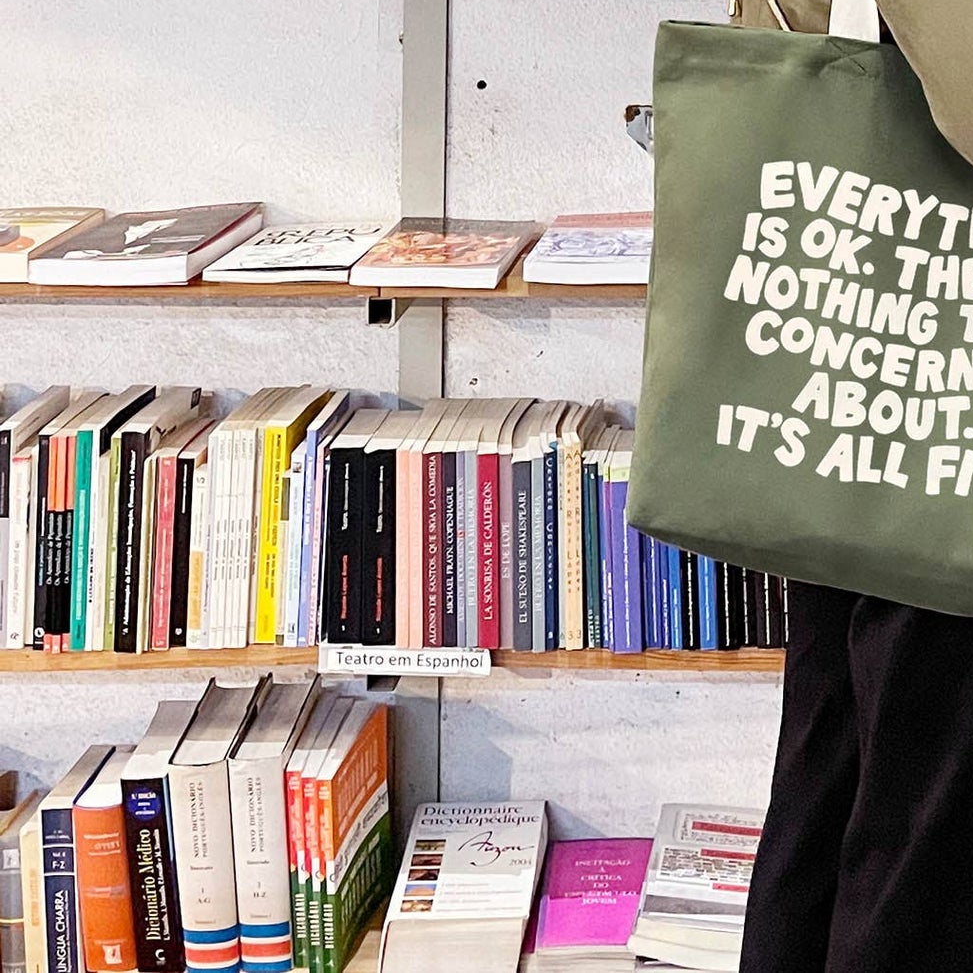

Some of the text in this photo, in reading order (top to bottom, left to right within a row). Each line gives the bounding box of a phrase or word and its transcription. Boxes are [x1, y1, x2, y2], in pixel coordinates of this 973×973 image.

[742, 212, 789, 258] IS
[800, 218, 875, 275] OK.
[723, 254, 939, 345] NOTHING
[717, 404, 811, 466] IT'S
[815, 433, 909, 489] ALL
[445, 486, 455, 544] COPENHAGUE
[427, 455, 438, 645] ALONSO DE SANTOS. QUE SIGA LA COMEDIA
[465, 488, 475, 607] BUERO EN LA MEMORIA
[481, 481, 494, 620] LA SONRISA DE CALDERÓN
[500, 522, 511, 580] ES DE LOPE
[517, 490, 528, 623] EL SUEÑO DE SHAKESPEARE
[445, 576, 455, 614] MICHAEL
[337, 651, 484, 671] Teatro em Espanhol
[188, 782, 200, 858] NOVO DICIONÁRIO
[197, 781, 208, 858] PORTUGUÊS-INGLÊS
[246, 777, 257, 853] NOVO DICIONÁRIO
[255, 777, 265, 853] PORTUGUÊS-INGLÊS
[420, 815, 541, 827] encyclopédique
[423, 805, 524, 817] Dictionnaire
[52, 860, 66, 869] F-Z
[137, 829, 155, 874] Médico
[580, 873, 623, 881] CRÍTICA
[54, 890, 66, 932] CHARRA
[141, 876, 162, 941] Dicionário
[592, 881, 609, 889] DO
[294, 893, 307, 938] DICIONÁRIO
[308, 901, 321, 946] DICIONÁRIO
[321, 903, 335, 949] DICIONÁRIO
